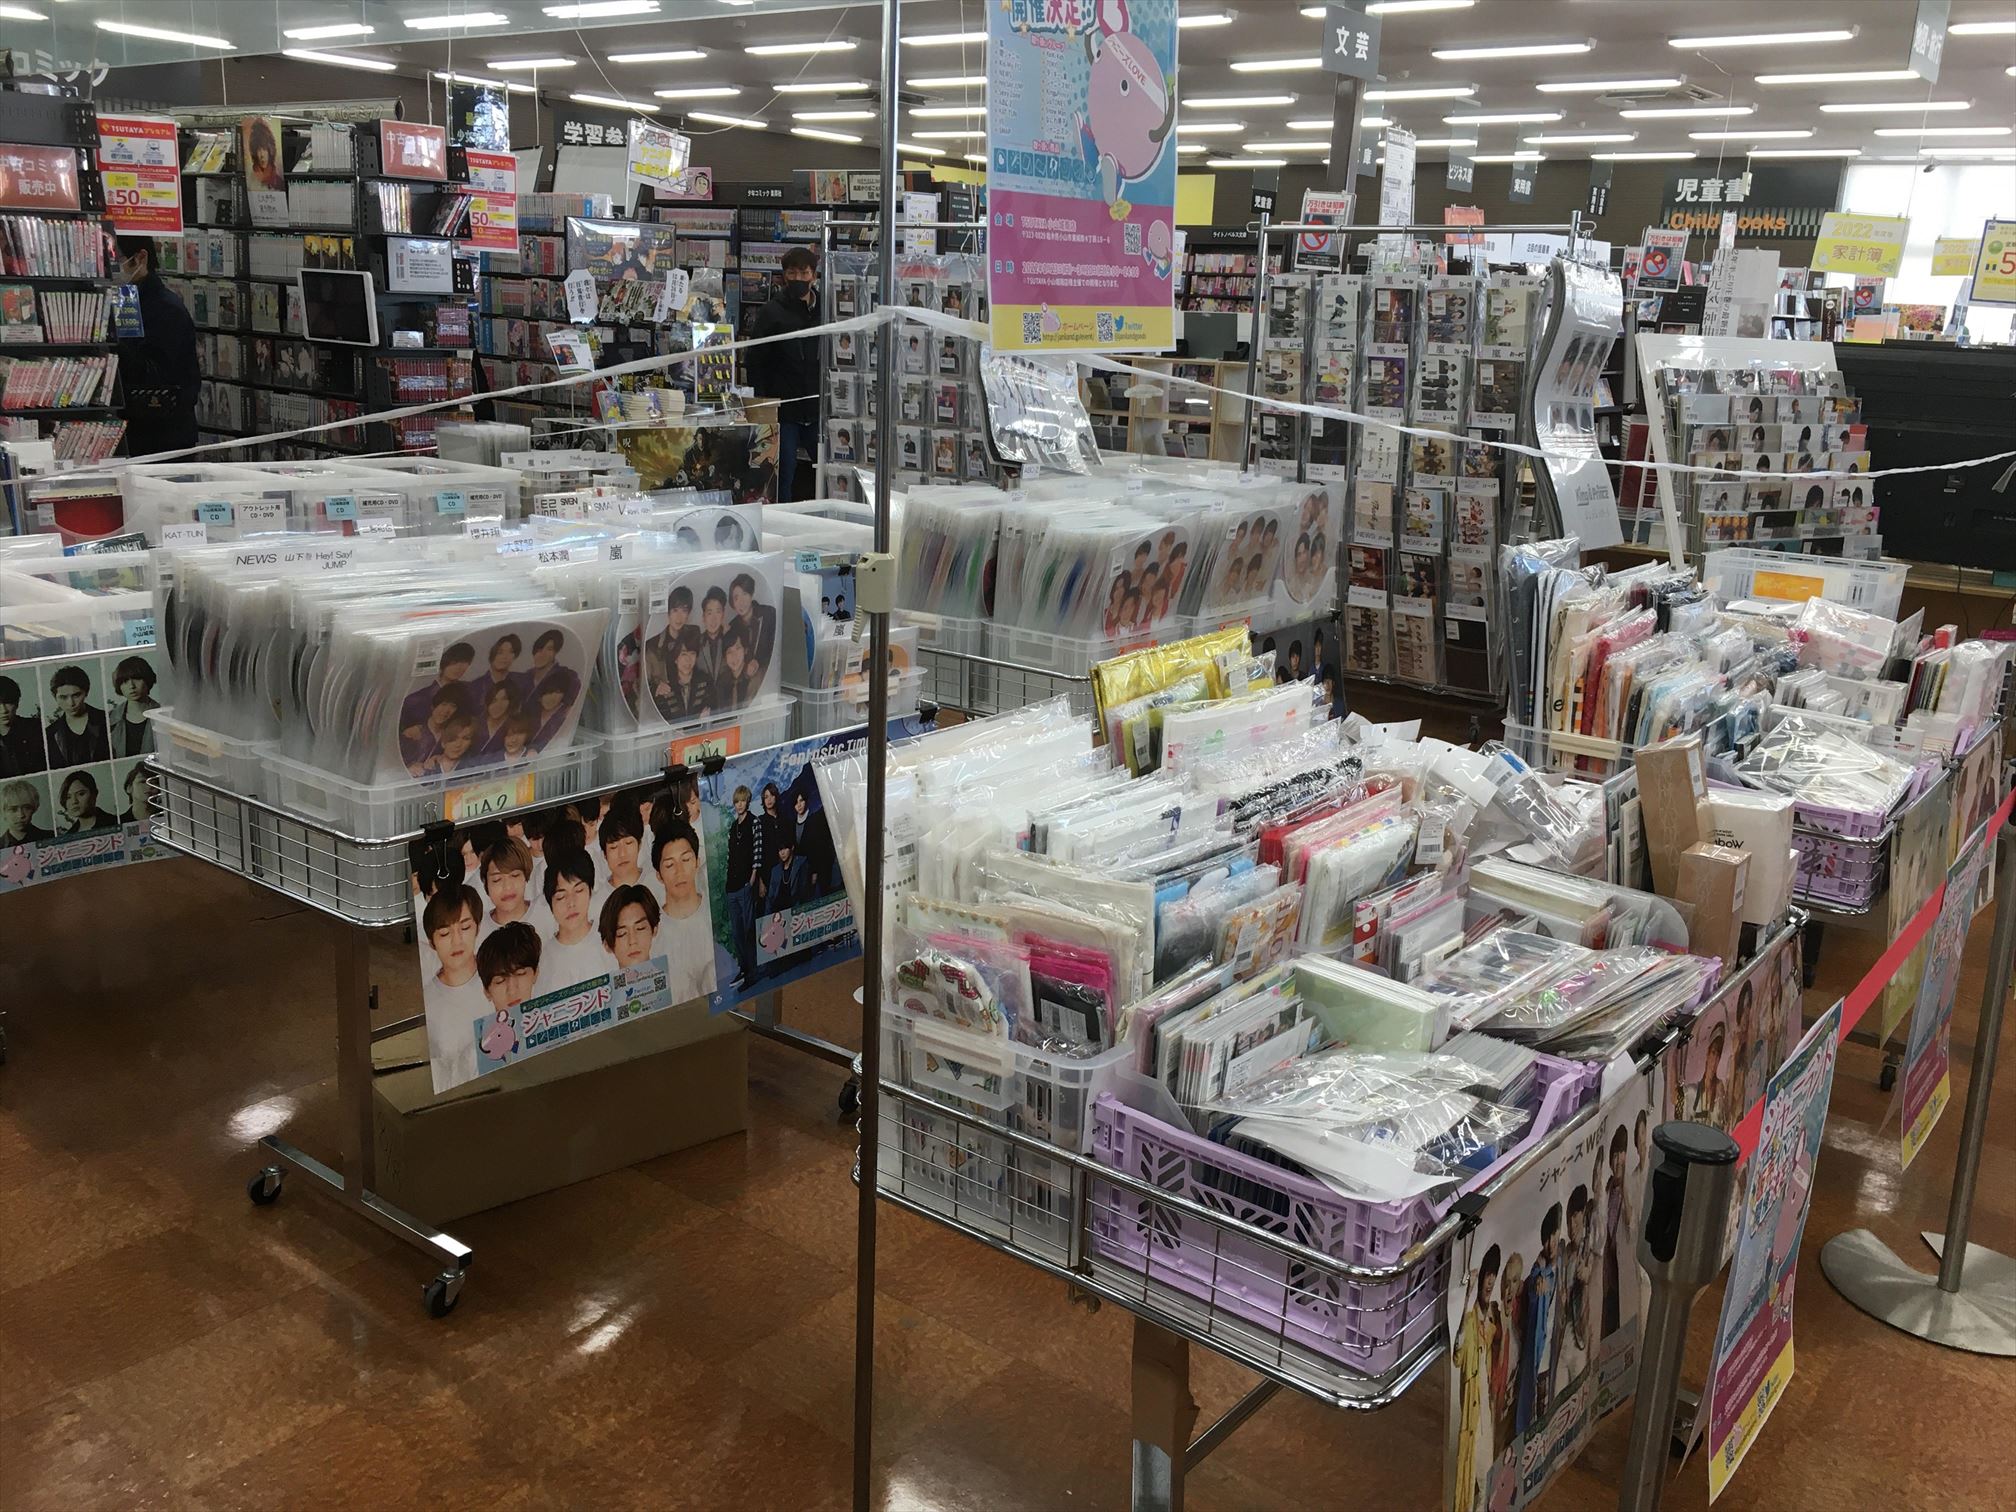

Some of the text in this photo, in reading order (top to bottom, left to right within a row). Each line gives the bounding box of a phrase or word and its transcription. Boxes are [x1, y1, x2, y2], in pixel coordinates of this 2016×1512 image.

[1335, 25, 1370, 61] 文芸
[112, 125, 144, 133] TSUTAYA
[564, 121, 628, 145] 学習参
[18, 178, 57, 197] 販売中
[1675, 177, 1746, 202] 児童書
[116, 190, 140, 205] 50
[471, 212, 489, 225] 50
[1737, 213, 1787, 230] ooks
[1832, 221, 1873, 238] 2022
[1832, 245, 1883, 262] 家計簿
[164, 530, 204, 539] KAT-TUN
[236, 553, 277, 566] NEWS
[315, 552, 334, 561] Hey!
[335, 550, 353, 560] Say!
[538, 549, 570, 563] 松本潤
[609, 544, 623, 561] 嵐
[322, 560, 347, 570] JUMP
[780, 736, 869, 769] Fantastic Tim
[37, 833, 125, 866] ジャニランド
[522, 986, 612, 1036] ジャニランド
[1539, 1114, 1609, 1192] ジャニーズ WEST
